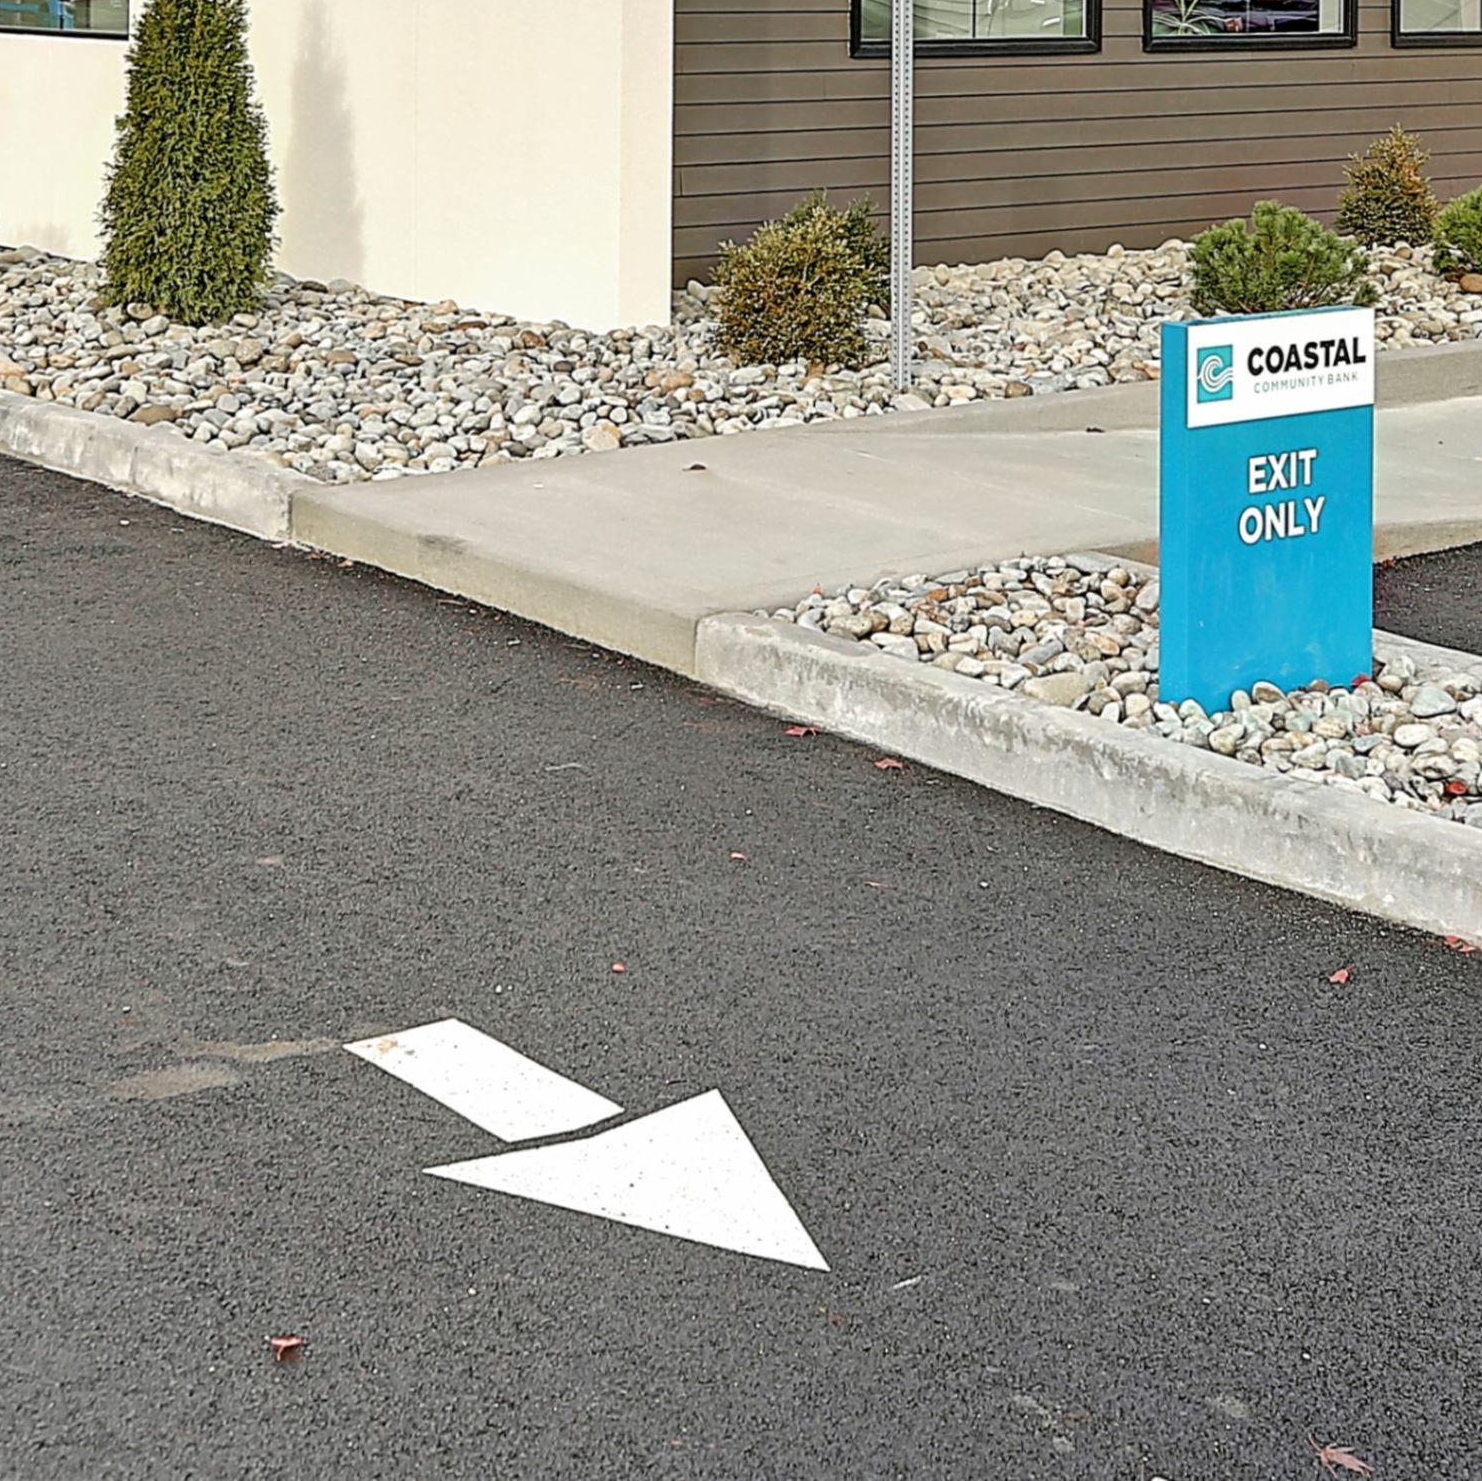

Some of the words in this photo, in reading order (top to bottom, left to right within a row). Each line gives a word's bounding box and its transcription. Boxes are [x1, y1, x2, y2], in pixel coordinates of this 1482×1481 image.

[1247, 336, 1366, 376] COASTAL
[1253, 374, 1324, 394] COMMUNITY
[1327, 371, 1358, 385] BANK
[1248, 449, 1318, 495] EXIT
[1239, 496, 1326, 545] ONLY
